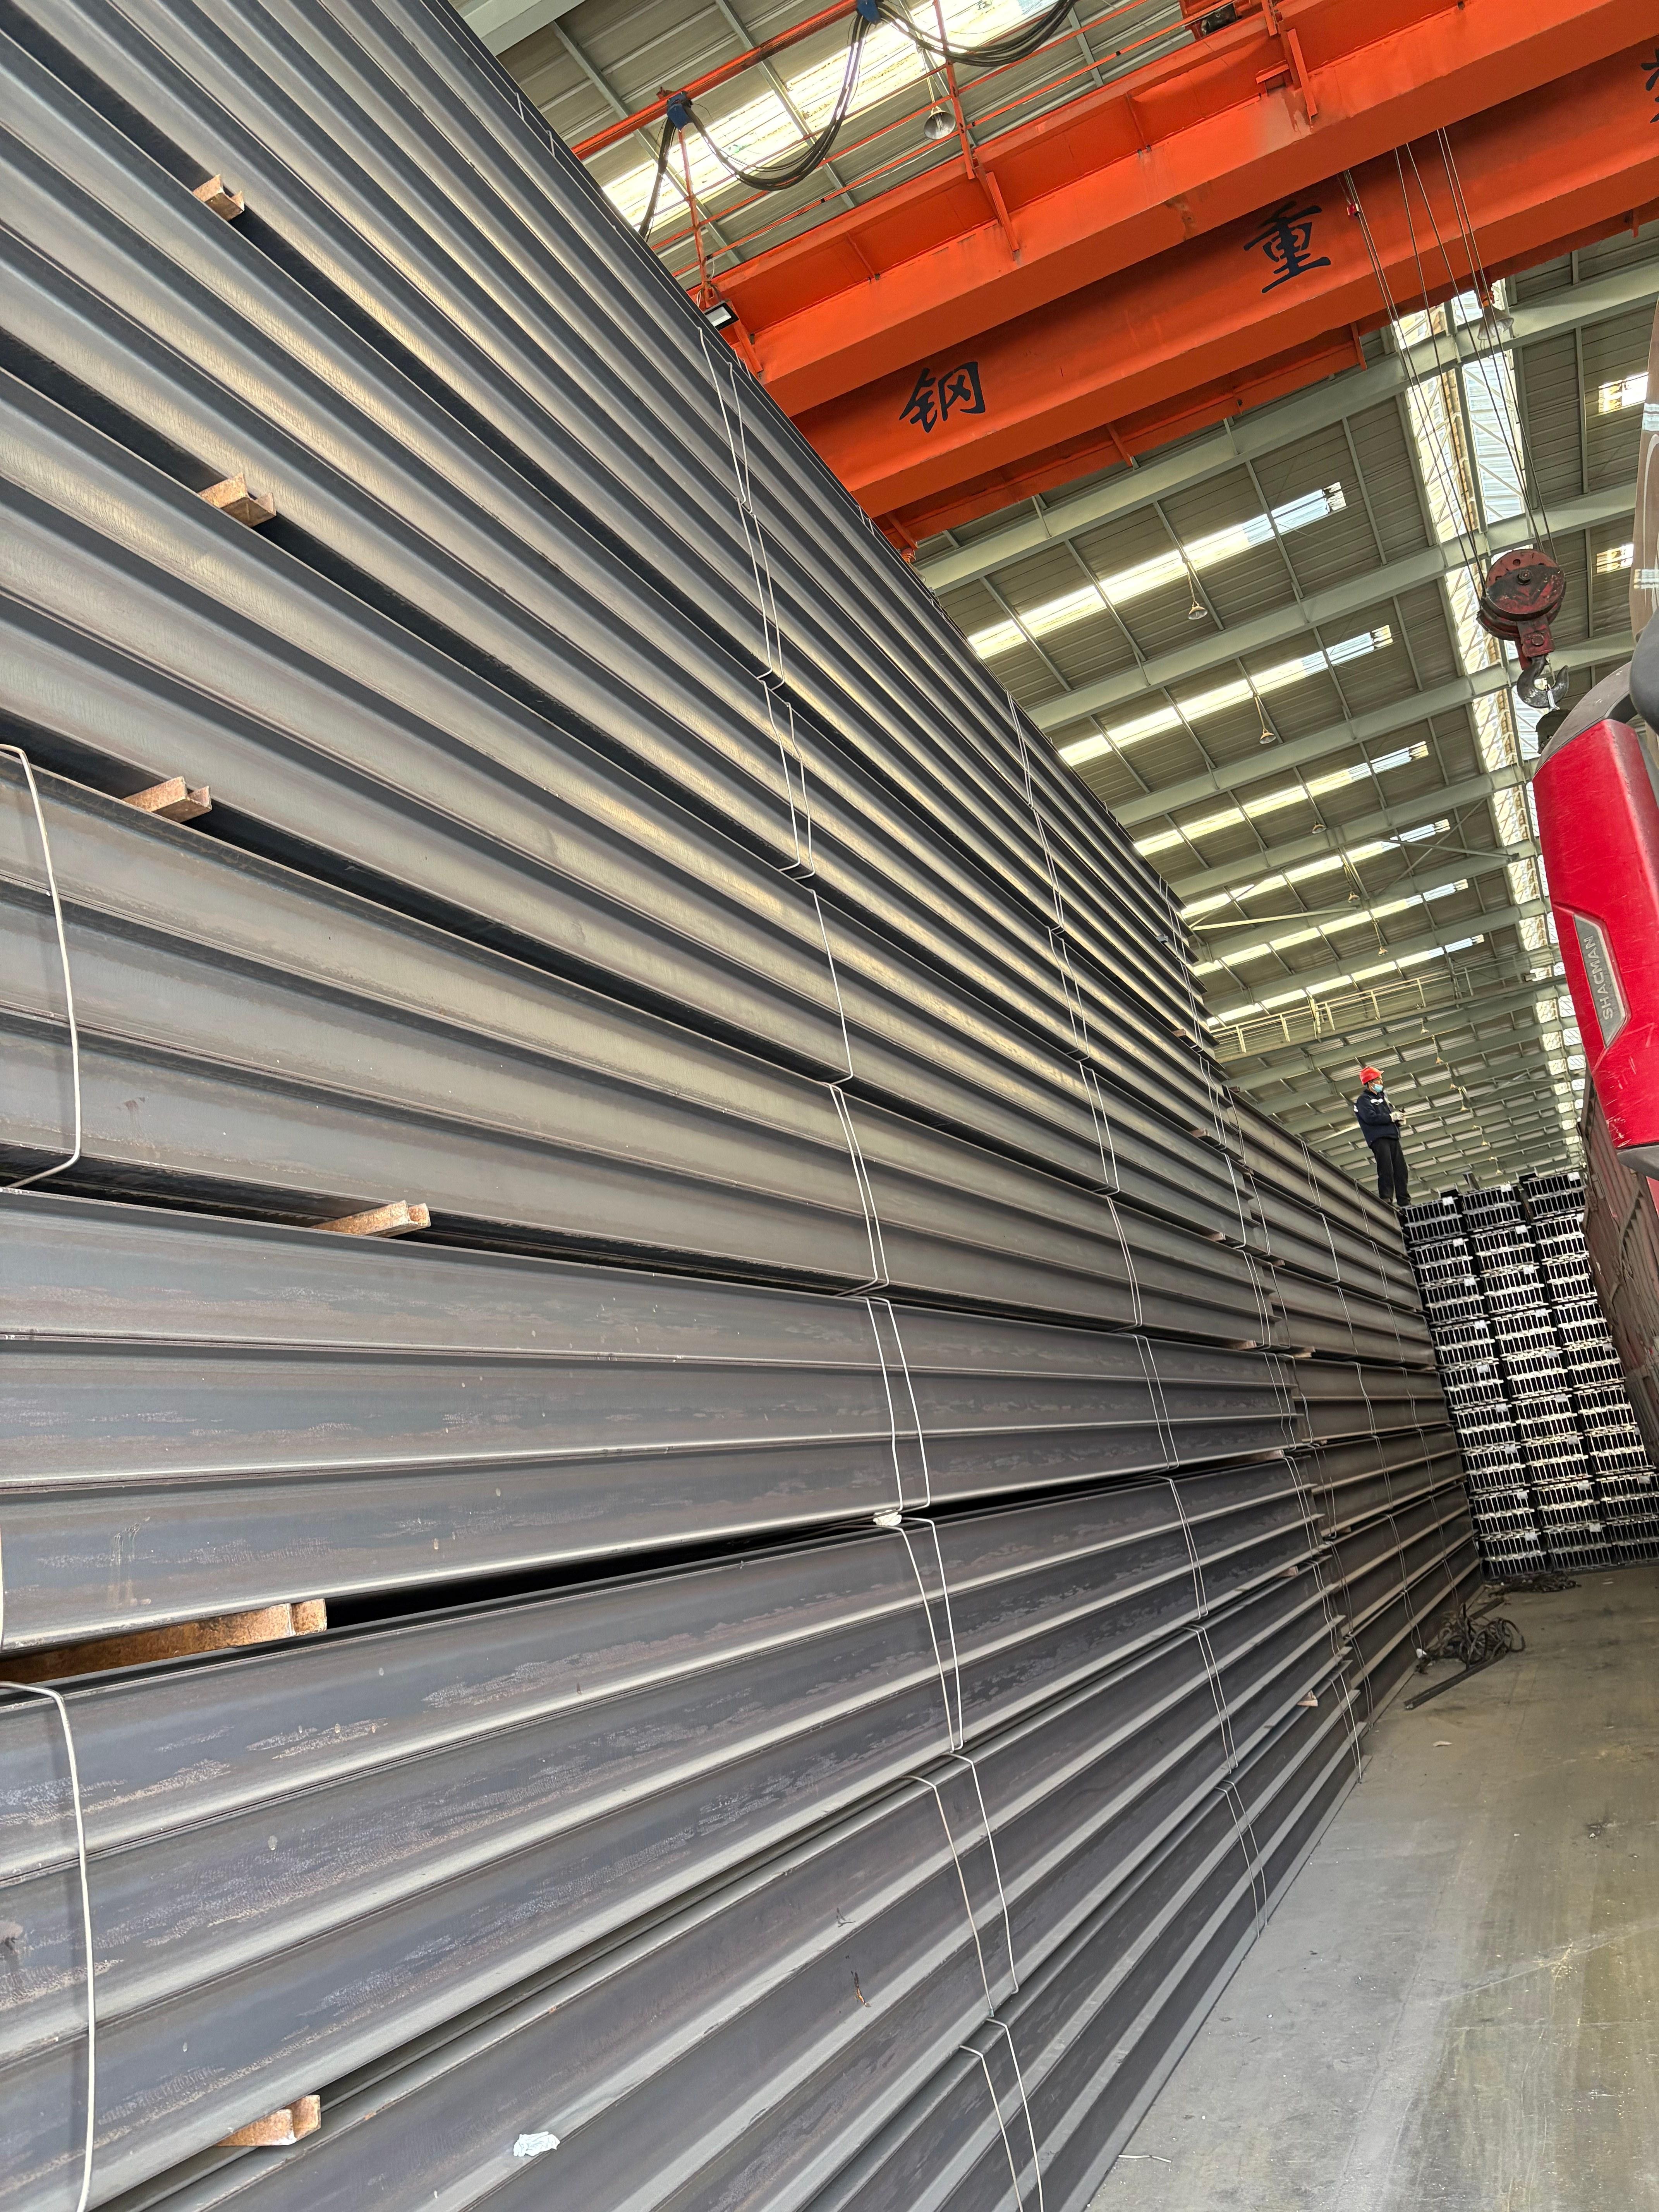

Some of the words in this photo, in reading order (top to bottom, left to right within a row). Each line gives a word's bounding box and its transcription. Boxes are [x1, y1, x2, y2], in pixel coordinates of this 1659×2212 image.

[899, 361, 986, 433] 钢
[1243, 201, 1331, 293] 重
[1584, 935, 1613, 1020] SHACMAN
